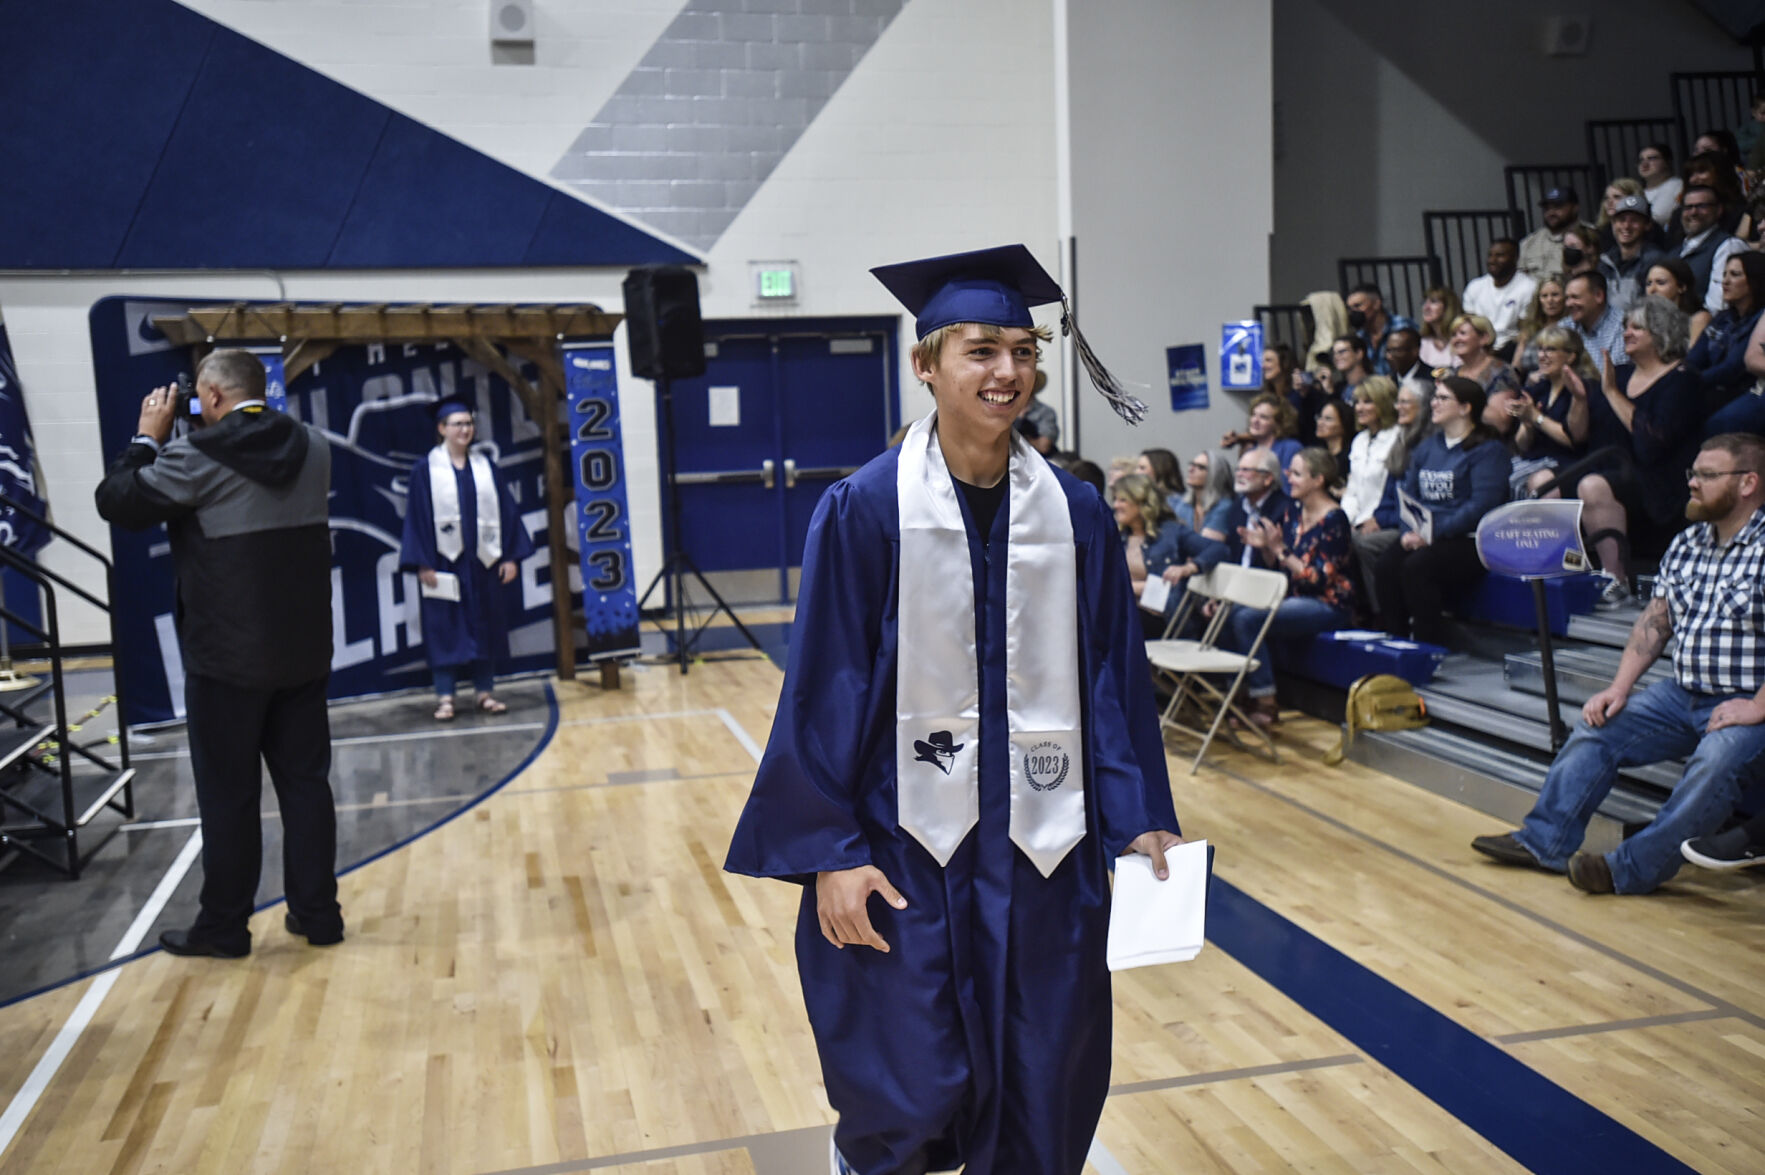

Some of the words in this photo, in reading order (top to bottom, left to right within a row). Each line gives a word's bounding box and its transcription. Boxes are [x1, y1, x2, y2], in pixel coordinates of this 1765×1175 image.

[1030, 741, 1051, 752] CLASS
[1052, 743, 1062, 751] OF
[1031, 755, 1059, 775] 2023
